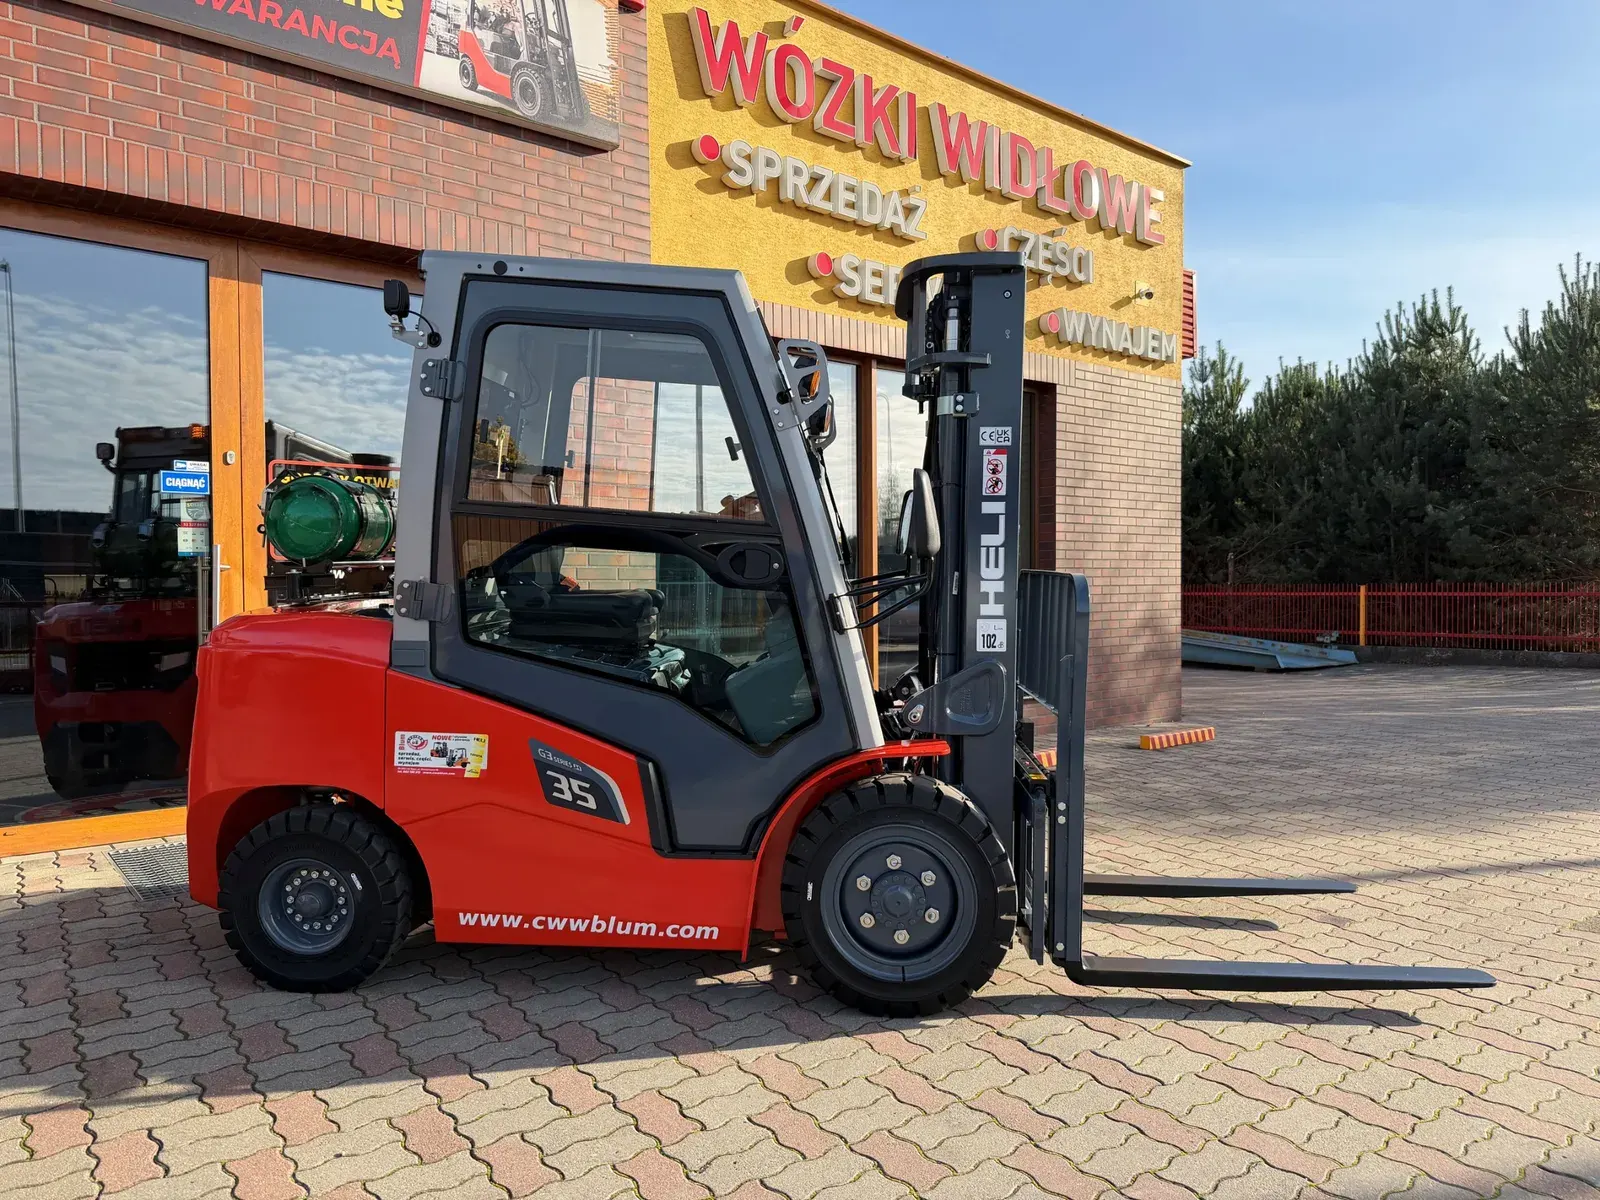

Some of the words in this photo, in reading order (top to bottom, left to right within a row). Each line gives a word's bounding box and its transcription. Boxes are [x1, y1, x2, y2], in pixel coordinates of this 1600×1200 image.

[687, 6, 917, 164] WÓZKI
[928, 101, 1165, 247] WIDŁOWE
[721, 139, 928, 242] SPRZEDAŻ
[998, 225, 1094, 286] CZĘŚCI
[1054, 306, 1177, 363] WYNAJEM
[980, 430, 995, 442] CE
[165, 476, 206, 490] CIĄGNĄĆ
[353, 475, 400, 489] OTWA
[979, 501, 1006, 616] HELI
[981, 633, 997, 649] 102
[537, 747, 553, 761] G3
[546, 770, 597, 810] 35
[458, 911, 720, 940] www.cwwblum.com
